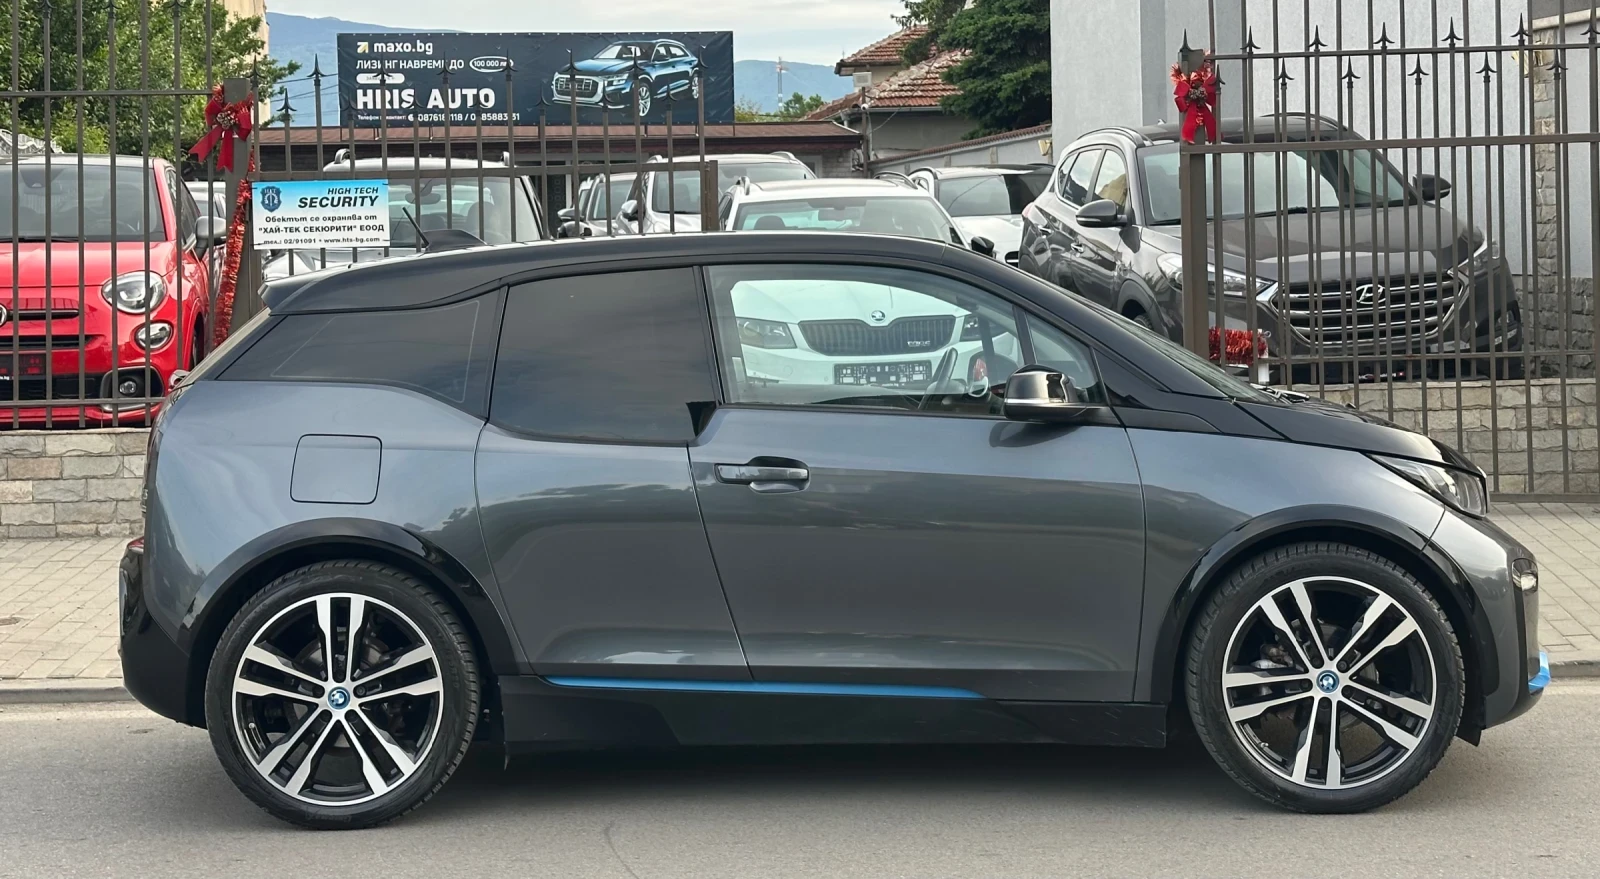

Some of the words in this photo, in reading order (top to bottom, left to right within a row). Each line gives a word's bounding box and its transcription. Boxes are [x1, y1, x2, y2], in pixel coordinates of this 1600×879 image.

[373, 40, 433, 55] maxo.bg
[449, 59, 465, 70] ДО
[356, 88, 415, 109] HRIS
[427, 88, 495, 109] AUTO
[327, 187, 351, 195] HIGH
[353, 186, 379, 194] TECH
[298, 195, 379, 208] SECURITY
[265, 215, 307, 223] Обектът
[322, 214, 362, 222] охранява
[360, 224, 385, 232] ЕООД
